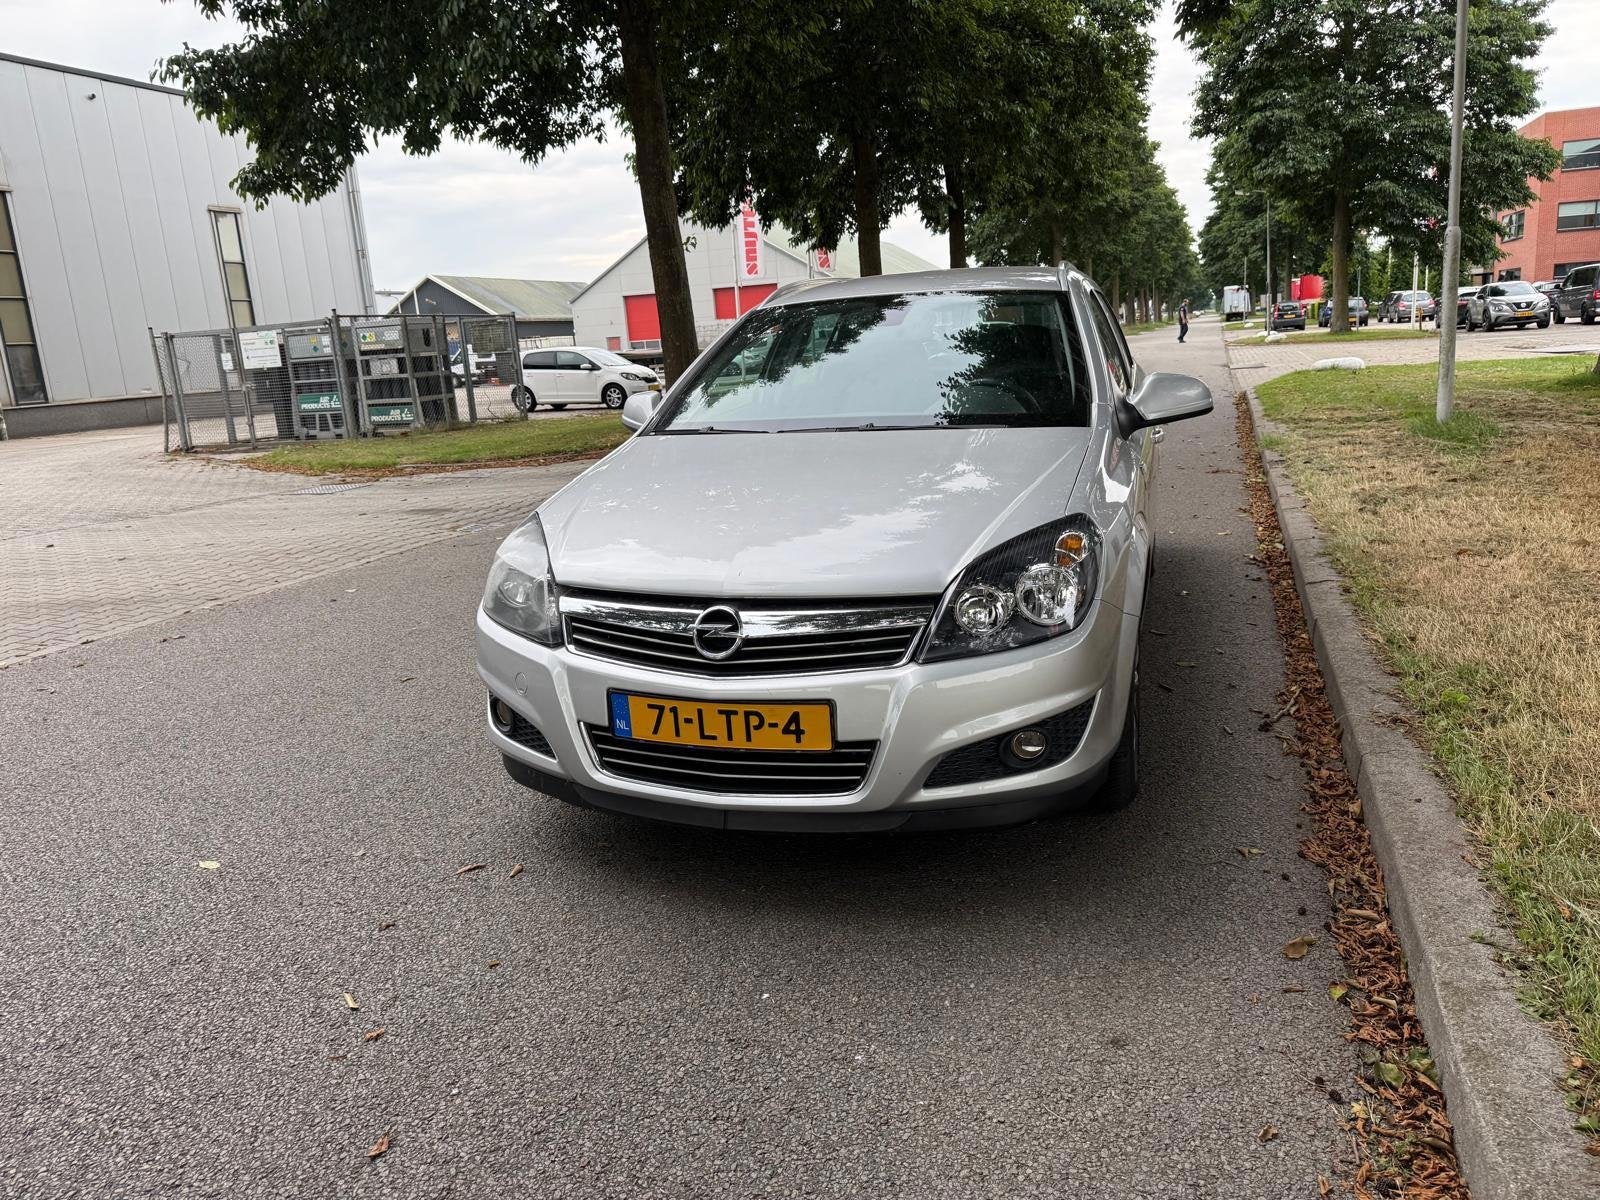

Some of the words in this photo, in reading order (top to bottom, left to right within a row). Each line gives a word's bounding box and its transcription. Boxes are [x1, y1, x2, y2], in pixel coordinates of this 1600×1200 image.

[301, 401, 331, 410] PRODUCTS
[390, 409, 401, 417] AIR
[616, 719, 630, 730] NL
[647, 703, 806, 743] 71-LTP-4
